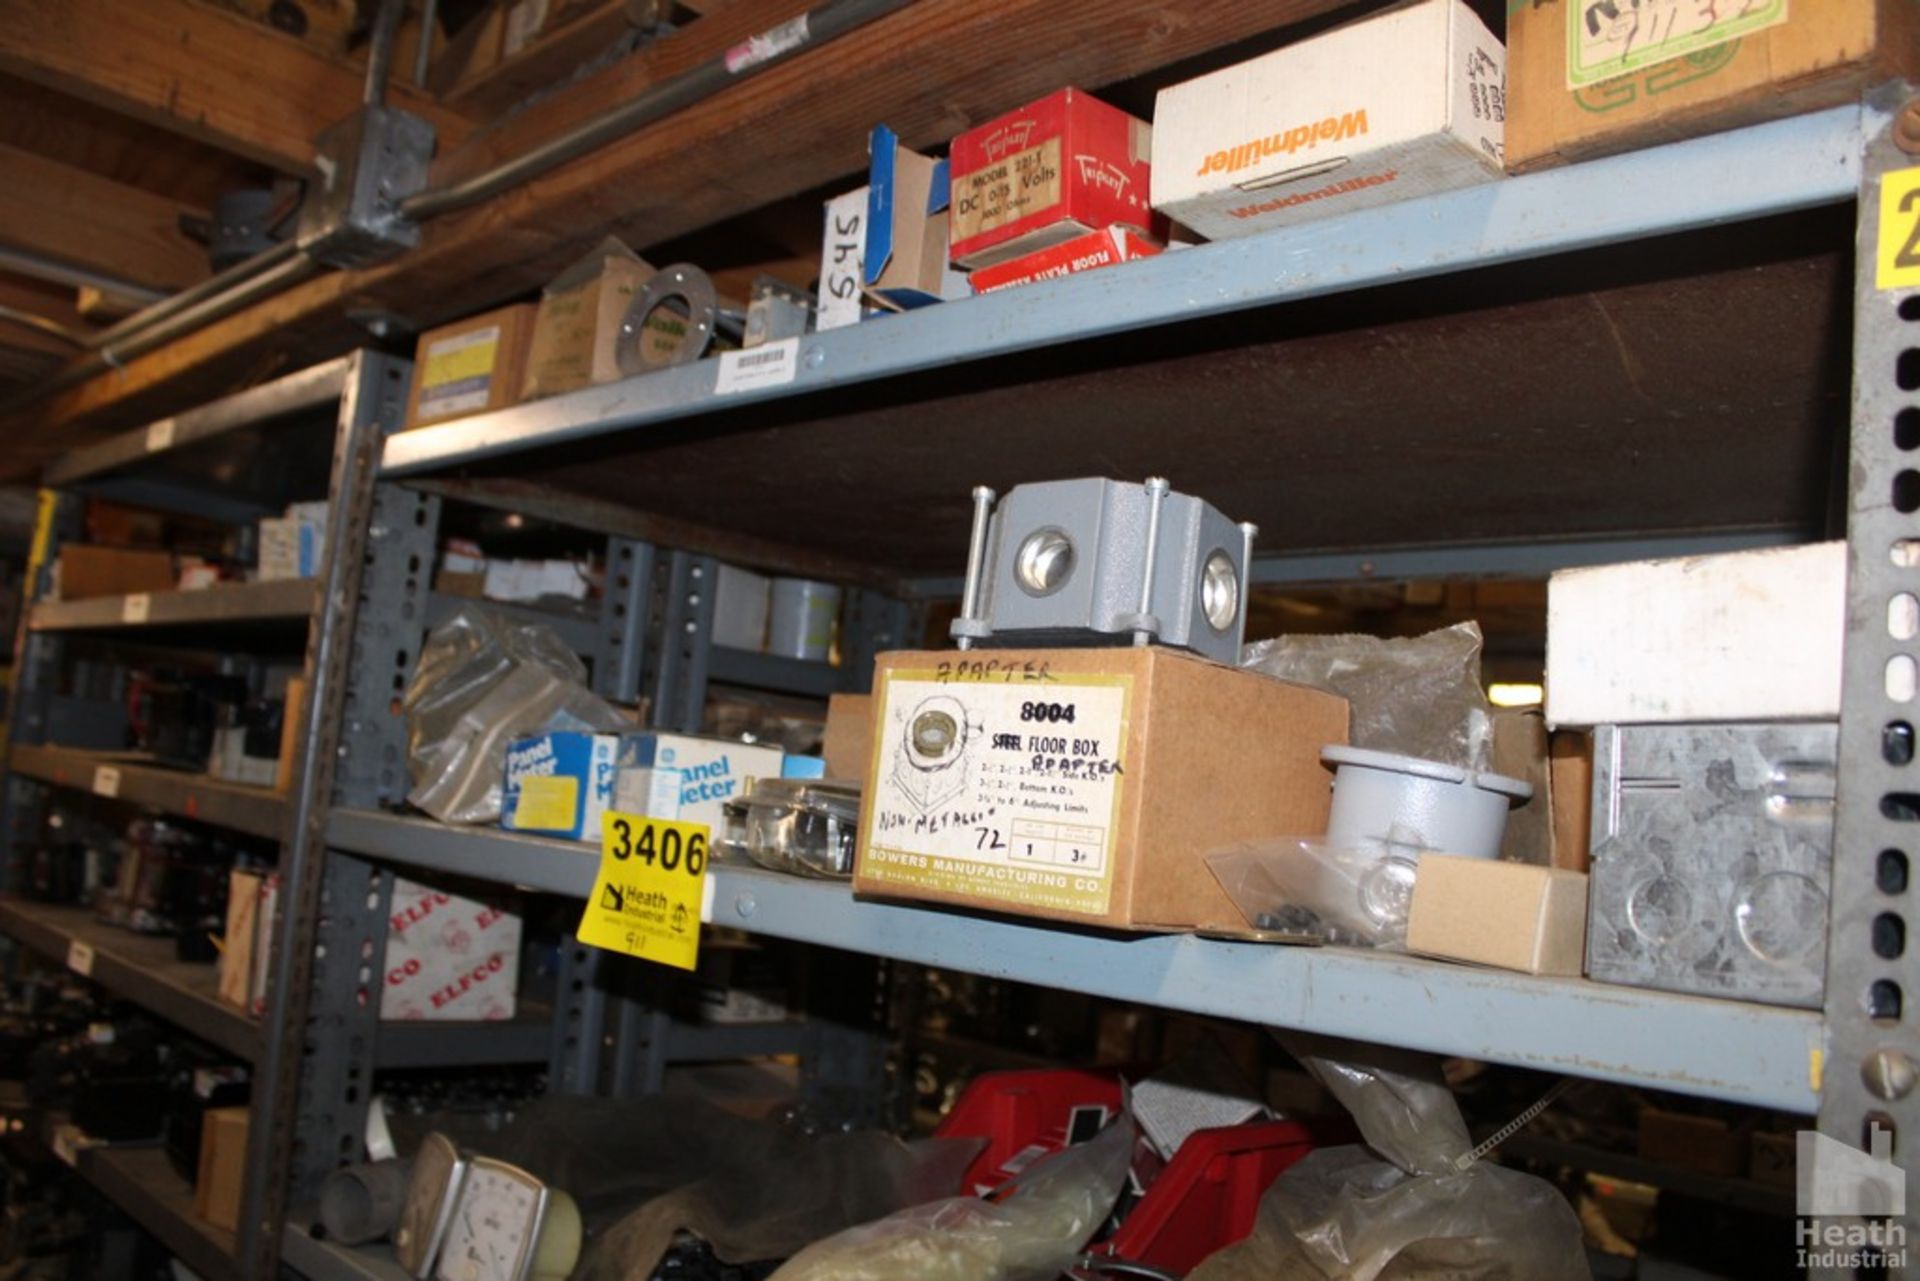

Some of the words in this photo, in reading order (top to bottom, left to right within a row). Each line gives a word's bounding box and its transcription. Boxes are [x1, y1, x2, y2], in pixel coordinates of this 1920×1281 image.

[960, 194, 979, 215] DC
[1022, 167, 1055, 189] Volts
[1072, 250, 1110, 271] FLOOR
[1020, 701, 1075, 723] 8004
[1029, 736, 1067, 755] FLOOR
[1072, 738, 1100, 757] BOX
[1023, 799, 1060, 812] Adjusting
[612, 820, 704, 876] 3406
[975, 827, 1006, 850] 72
[868, 849, 928, 870] BOWERS
[933, 858, 1067, 889] MANUFACTURING
[625, 884, 668, 910] Heath
[430, 953, 502, 1009] ELFCO
